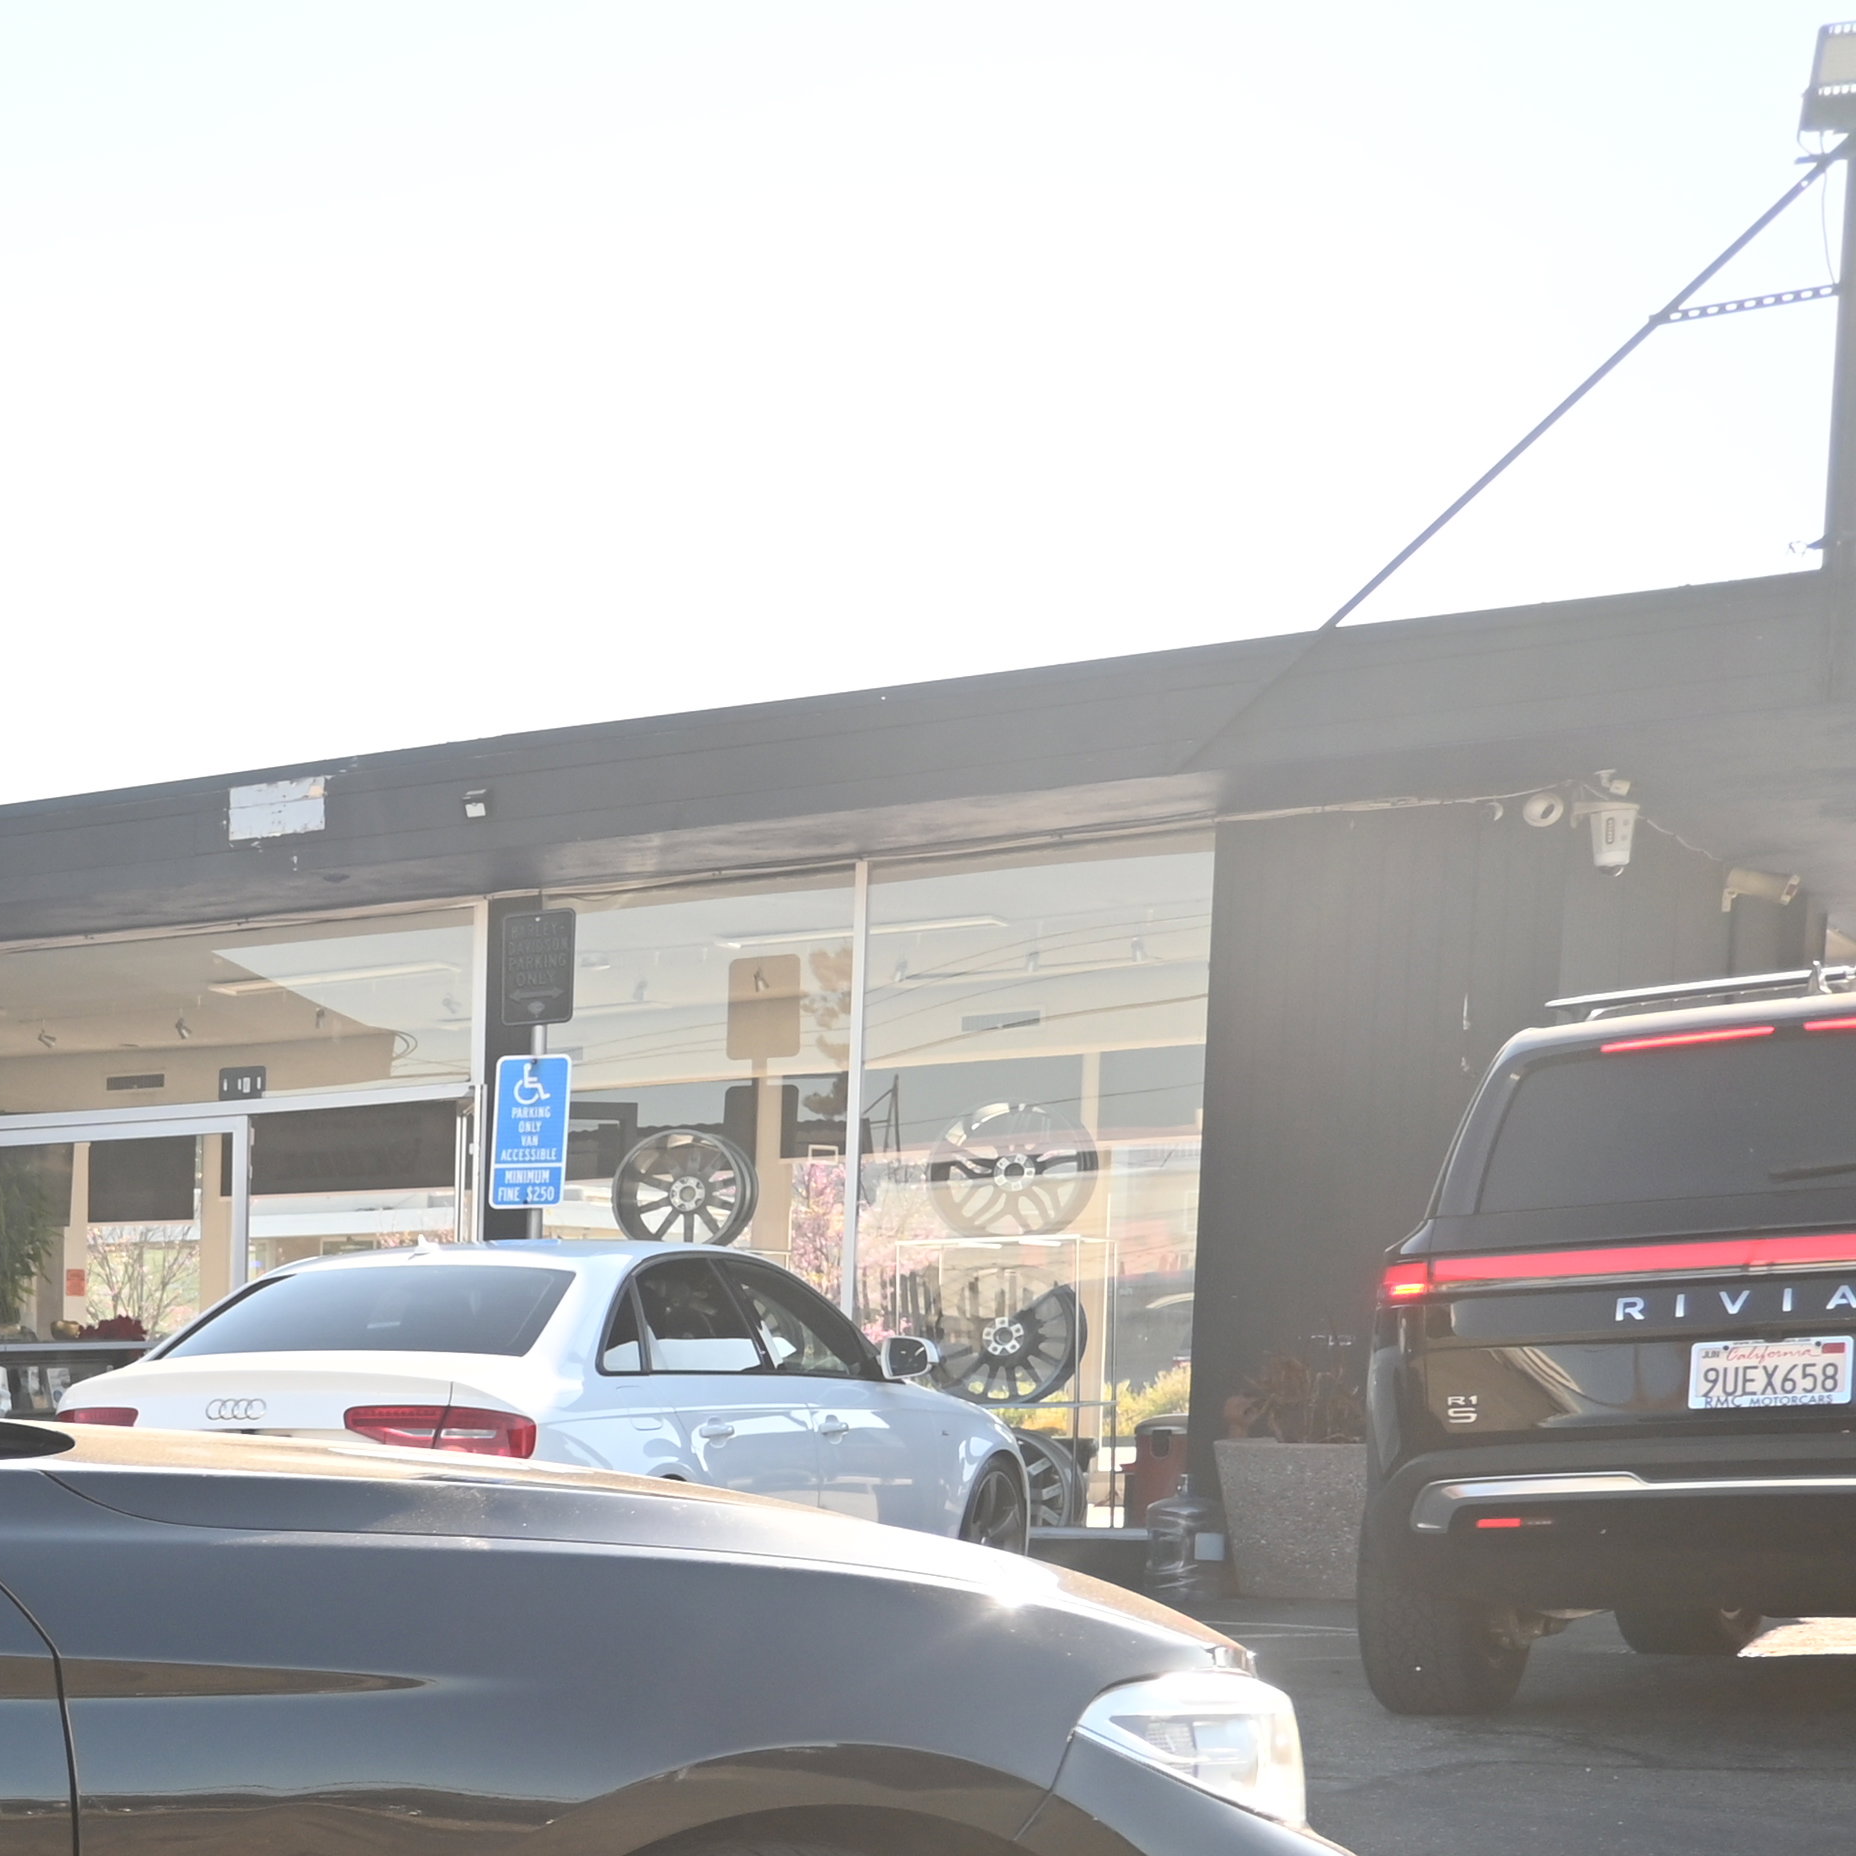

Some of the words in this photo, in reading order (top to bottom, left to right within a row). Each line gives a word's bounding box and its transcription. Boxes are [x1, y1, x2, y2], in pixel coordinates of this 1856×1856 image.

[508, 952, 568, 971] PARKING
[515, 969, 556, 988] ONLY
[511, 1106, 552, 1119] PARKING
[518, 1120, 542, 1133] ONLY
[520, 1135, 539, 1147] VAN
[500, 1148, 557, 1161] ACCESSIBLE
[504, 1169, 550, 1184] MINIMUM
[498, 1187, 520, 1202] FINE
[526, 1185, 555, 1202] $250
[1726, 1345, 1820, 1364] California
[1703, 1362, 1839, 1397] 9UEX658
[1448, 1395, 1478, 1406] R1
[1704, 1396, 1743, 1409] RMC
[1750, 1394, 1833, 1407] MOTORCARS
[1448, 1407, 1478, 1423] S
